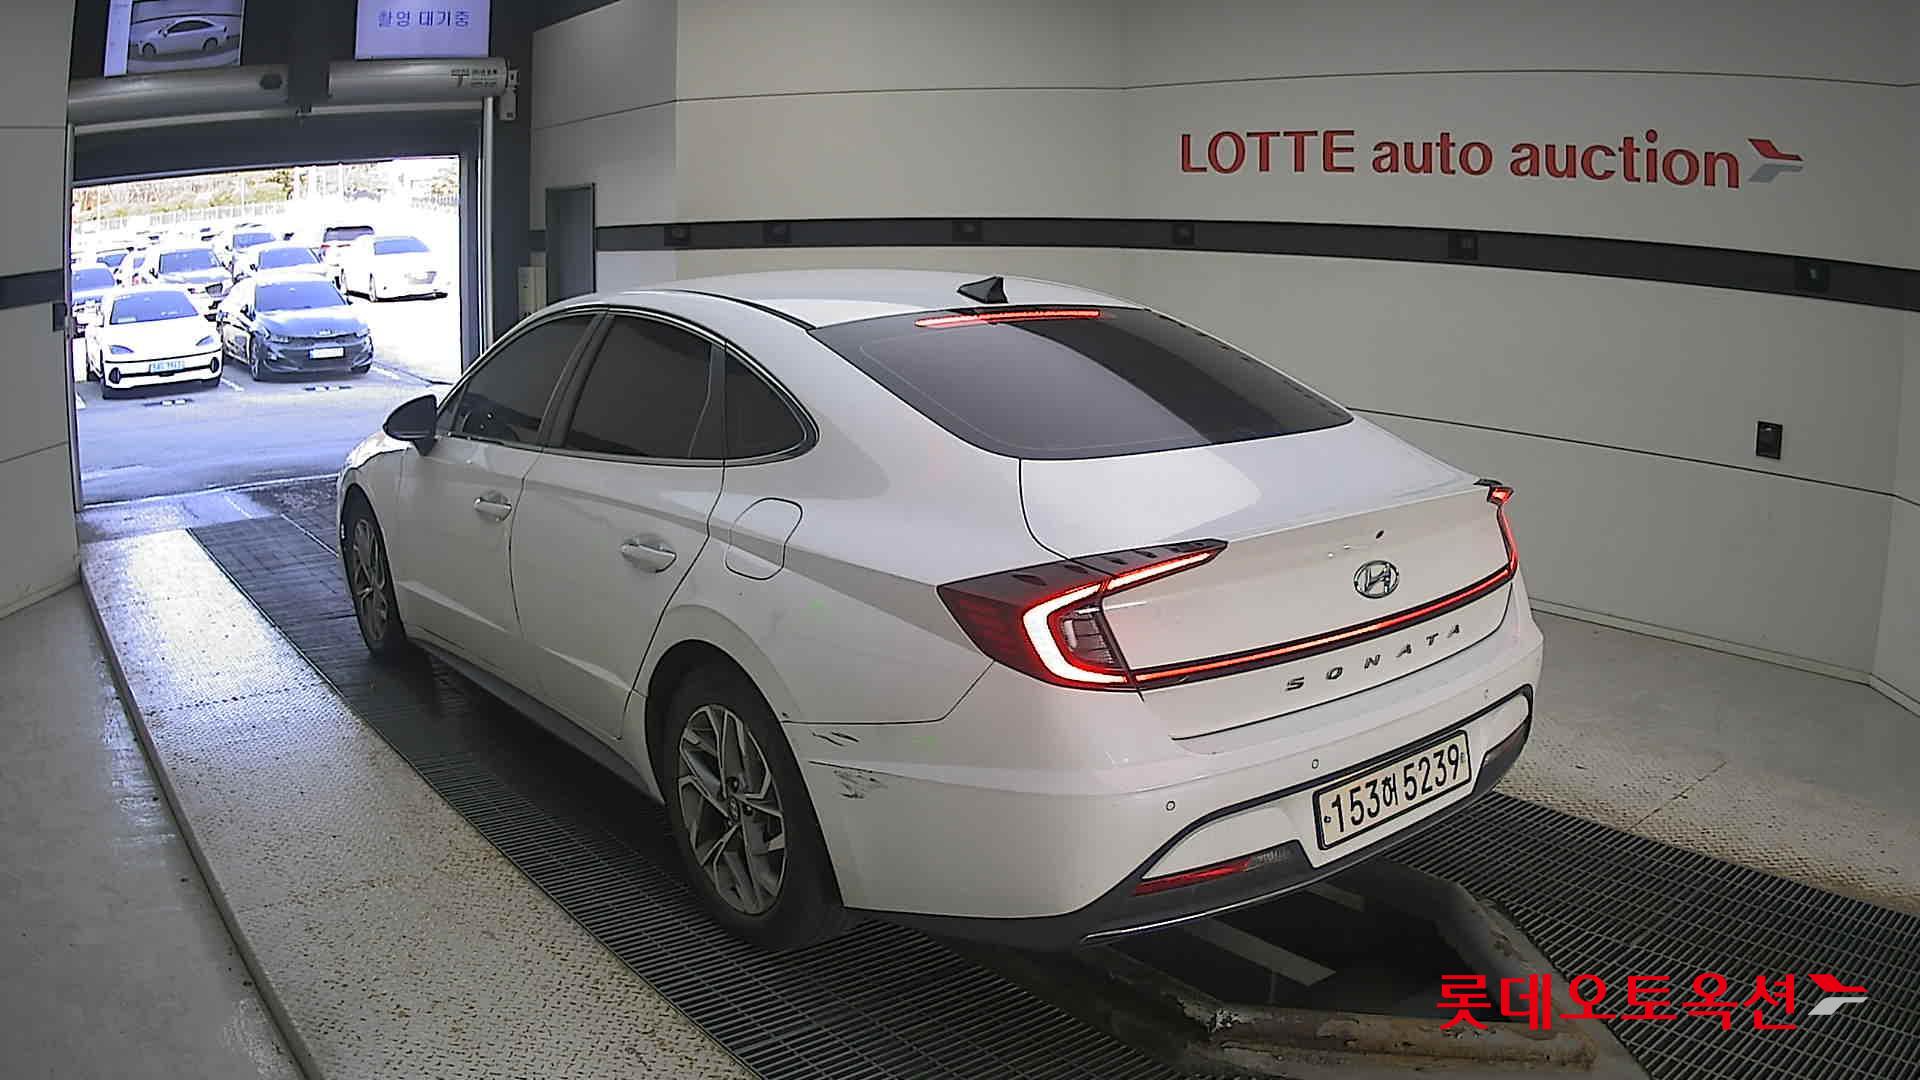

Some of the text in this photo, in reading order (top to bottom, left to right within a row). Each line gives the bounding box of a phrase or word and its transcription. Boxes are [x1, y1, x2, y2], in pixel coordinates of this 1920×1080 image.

[419, 10, 469, 27] 대기중
[1180, 130, 1740, 188] LOTTE auto auction
[1285, 624, 1460, 691] SONATA
